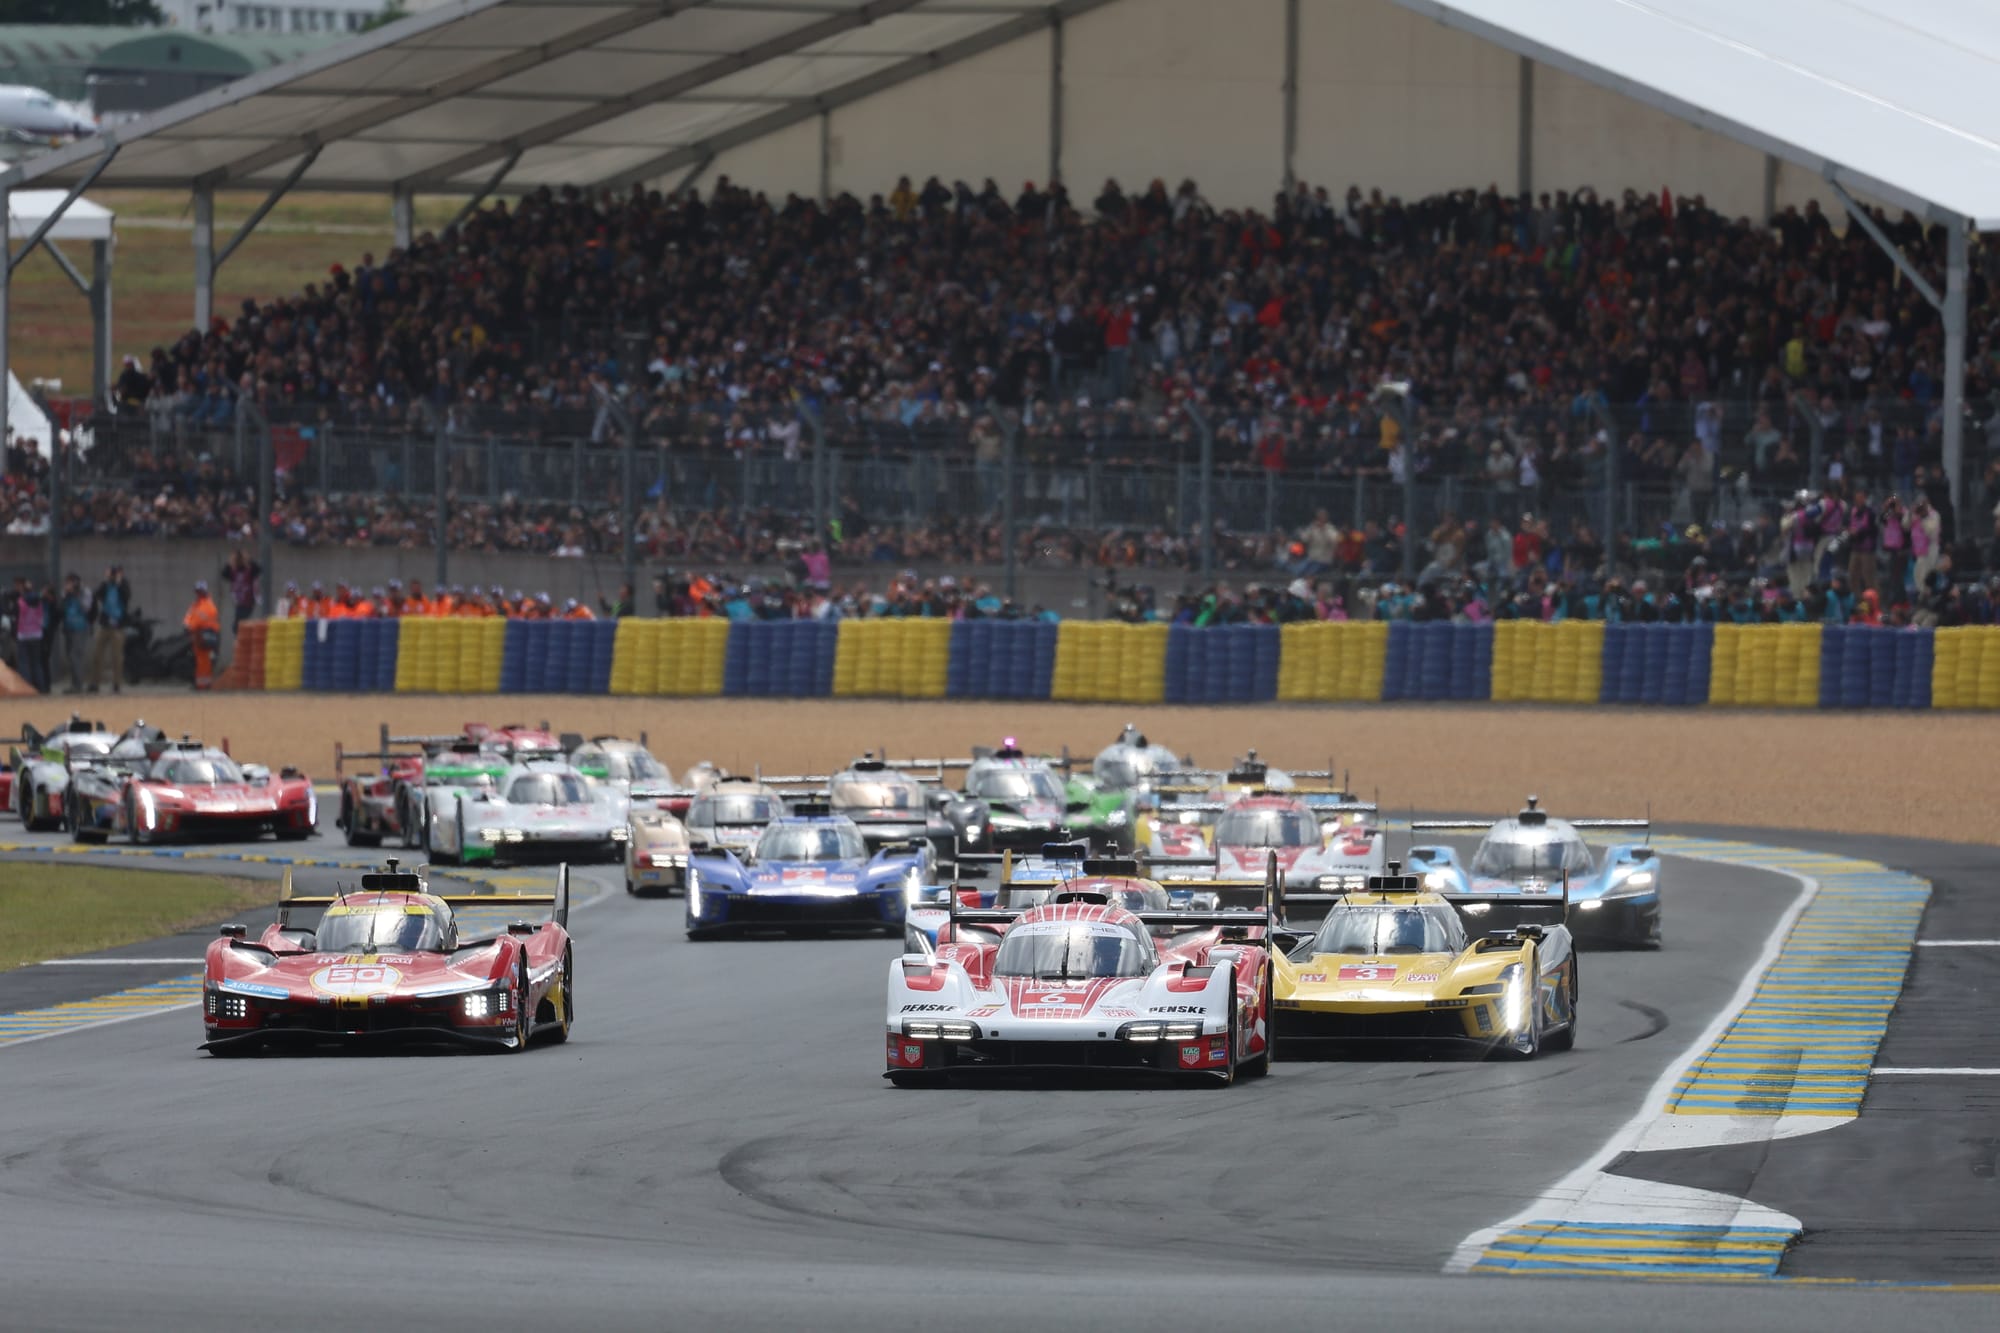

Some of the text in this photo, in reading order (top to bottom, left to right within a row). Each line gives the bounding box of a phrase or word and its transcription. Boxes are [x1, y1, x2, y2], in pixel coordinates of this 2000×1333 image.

[330, 969, 383, 981] 50
[1301, 974, 1324, 982] HY
[1355, 968, 1377, 980] 3
[1040, 993, 1066, 1003] 6
[901, 1003, 957, 1013] PENSKE
[1148, 1005, 1207, 1015] PENSKE
